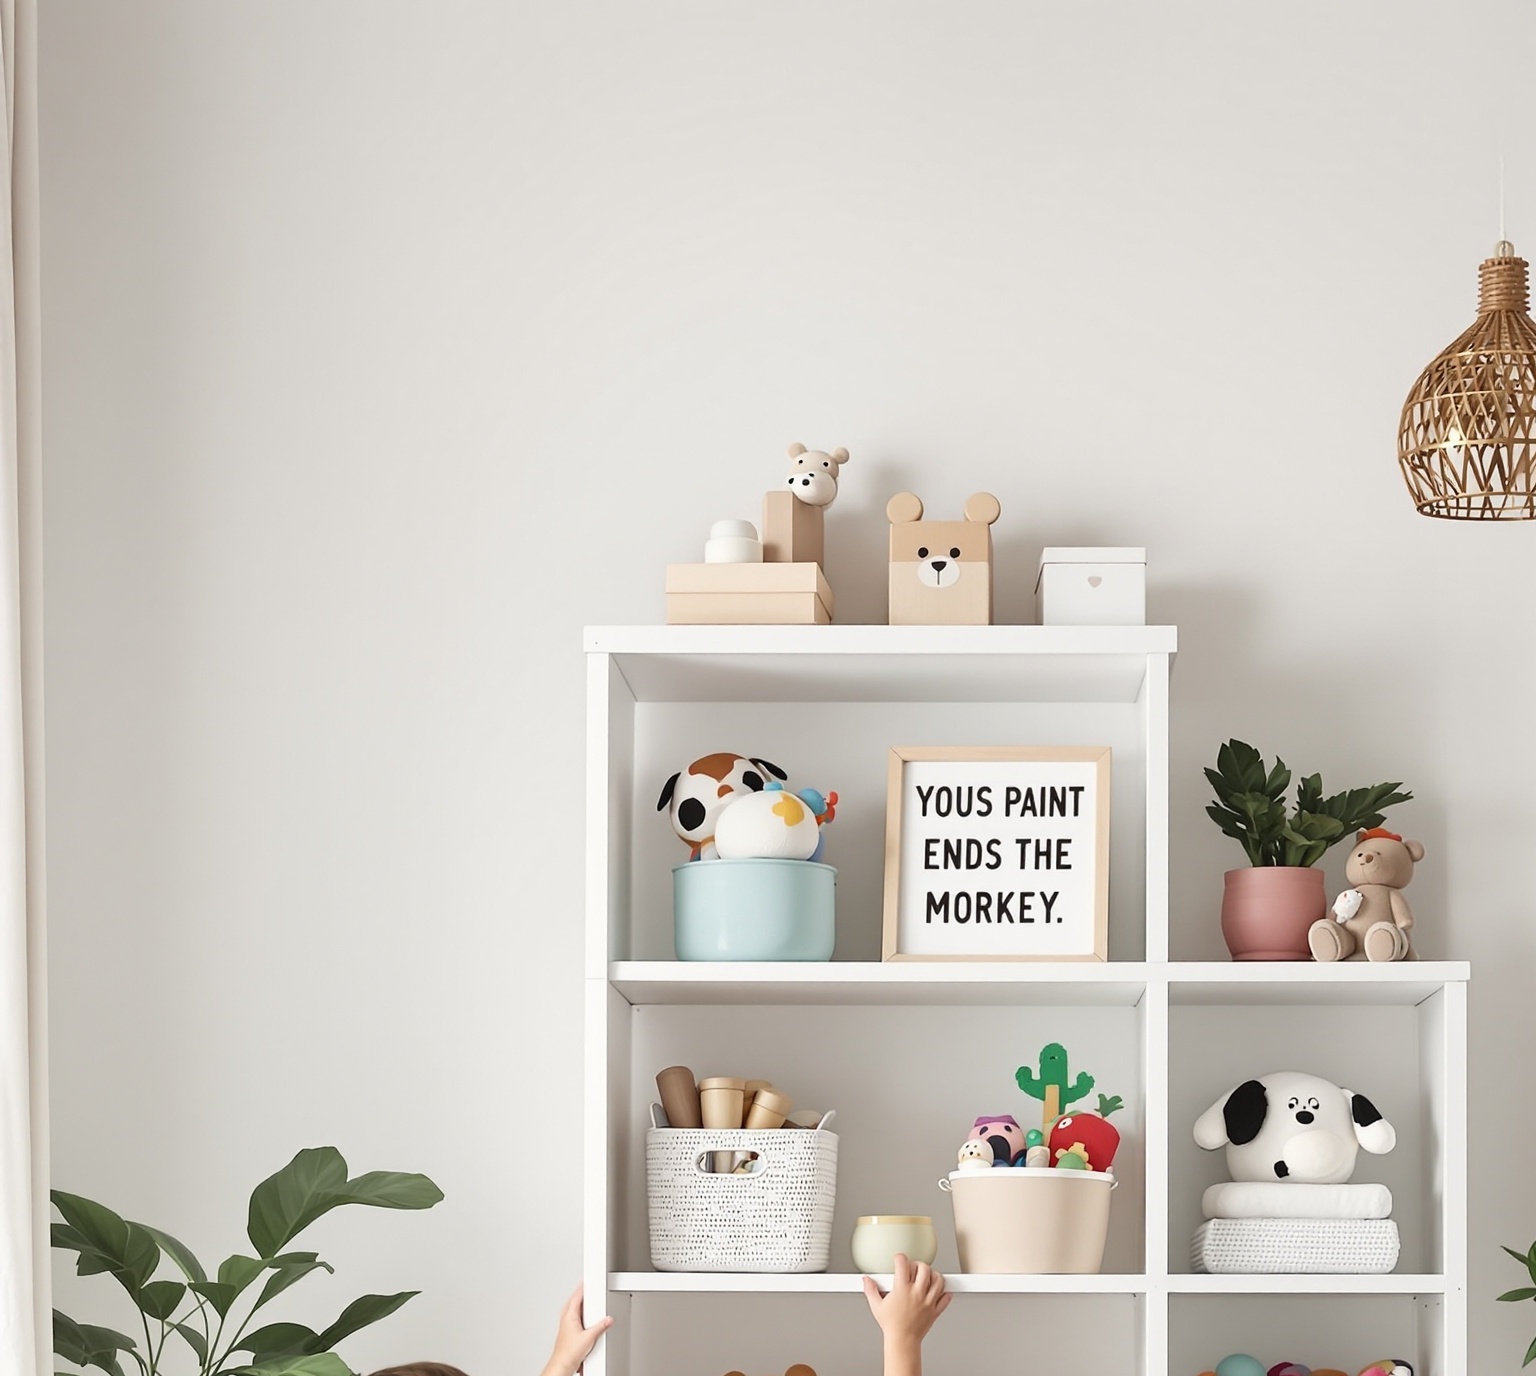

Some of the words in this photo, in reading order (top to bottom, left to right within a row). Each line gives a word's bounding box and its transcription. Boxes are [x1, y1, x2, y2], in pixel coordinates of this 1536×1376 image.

[915, 785, 993, 818] YOUS
[1004, 785, 1085, 818] PAINT
[923, 838, 1002, 870] ENDS
[1015, 838, 1072, 870] THE
[925, 891, 1063, 924] MORKEY.
